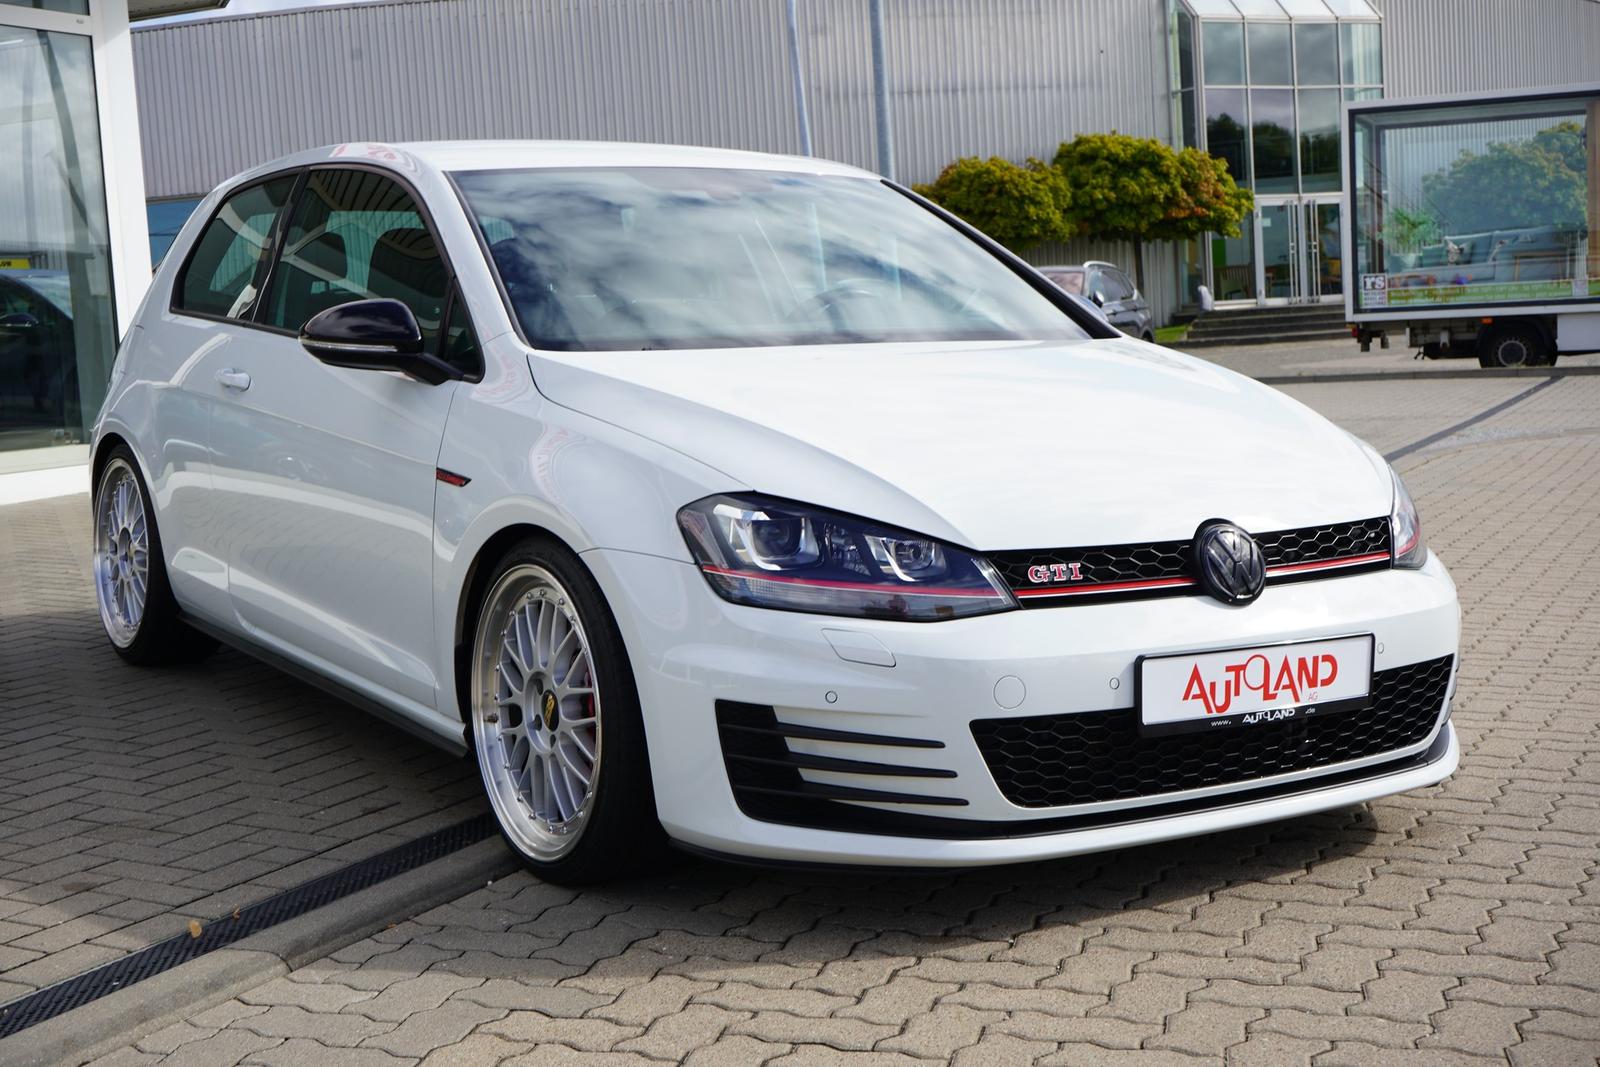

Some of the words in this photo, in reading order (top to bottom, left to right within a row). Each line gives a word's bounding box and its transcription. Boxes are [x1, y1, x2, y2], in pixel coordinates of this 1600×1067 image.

[1027, 561, 1083, 583] GTI
[1182, 654, 1338, 714] AUTOLAND
[1242, 708, 1295, 724] AUTOLAND
